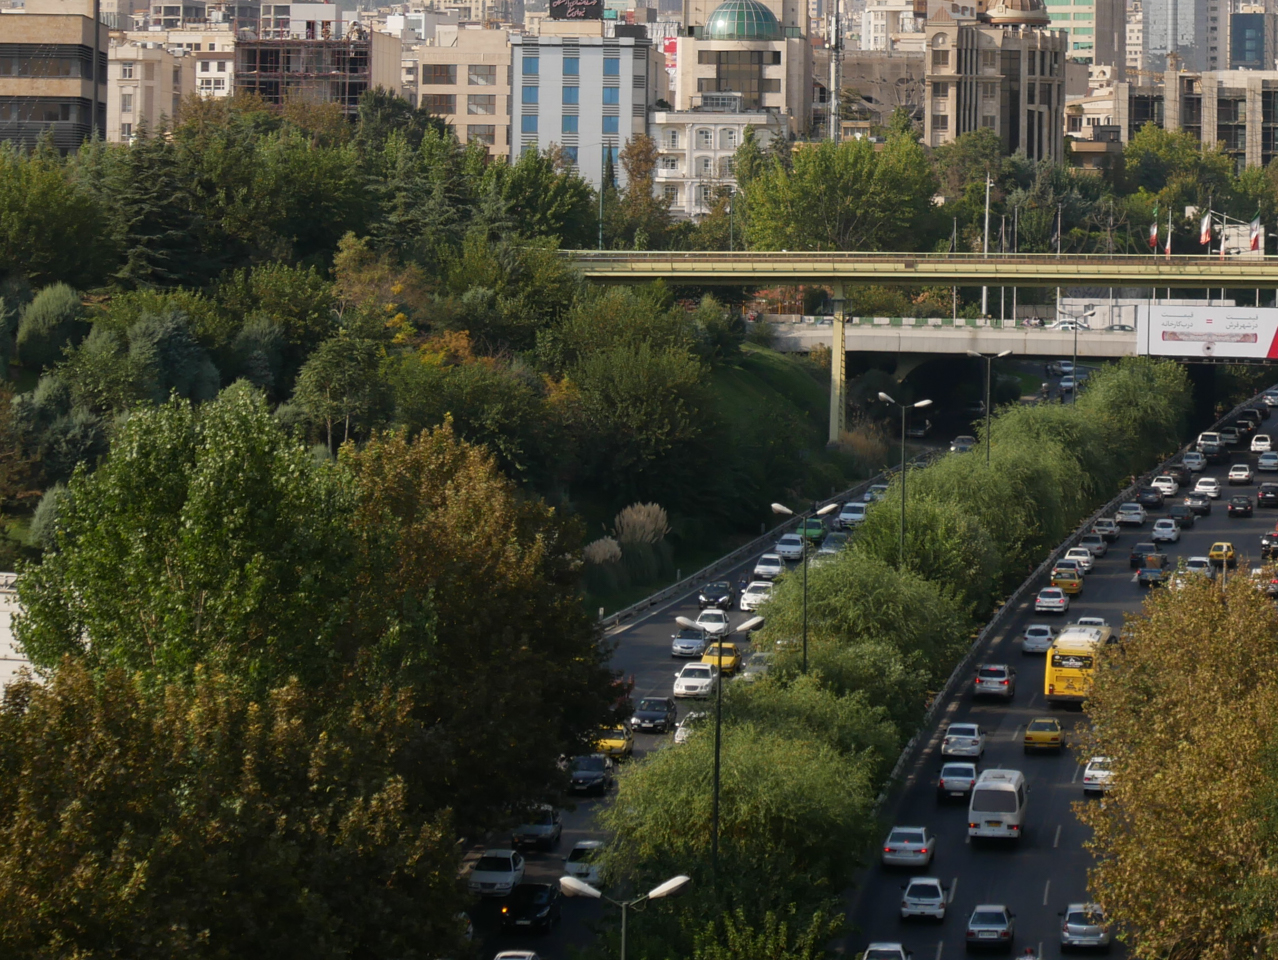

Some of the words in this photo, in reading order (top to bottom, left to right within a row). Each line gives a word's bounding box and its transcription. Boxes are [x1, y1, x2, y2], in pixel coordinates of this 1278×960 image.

[951, 3, 975, 18] BPI
[1161, 311, 1194, 320] قیمت
[1226, 314, 1258, 322] قیمت
